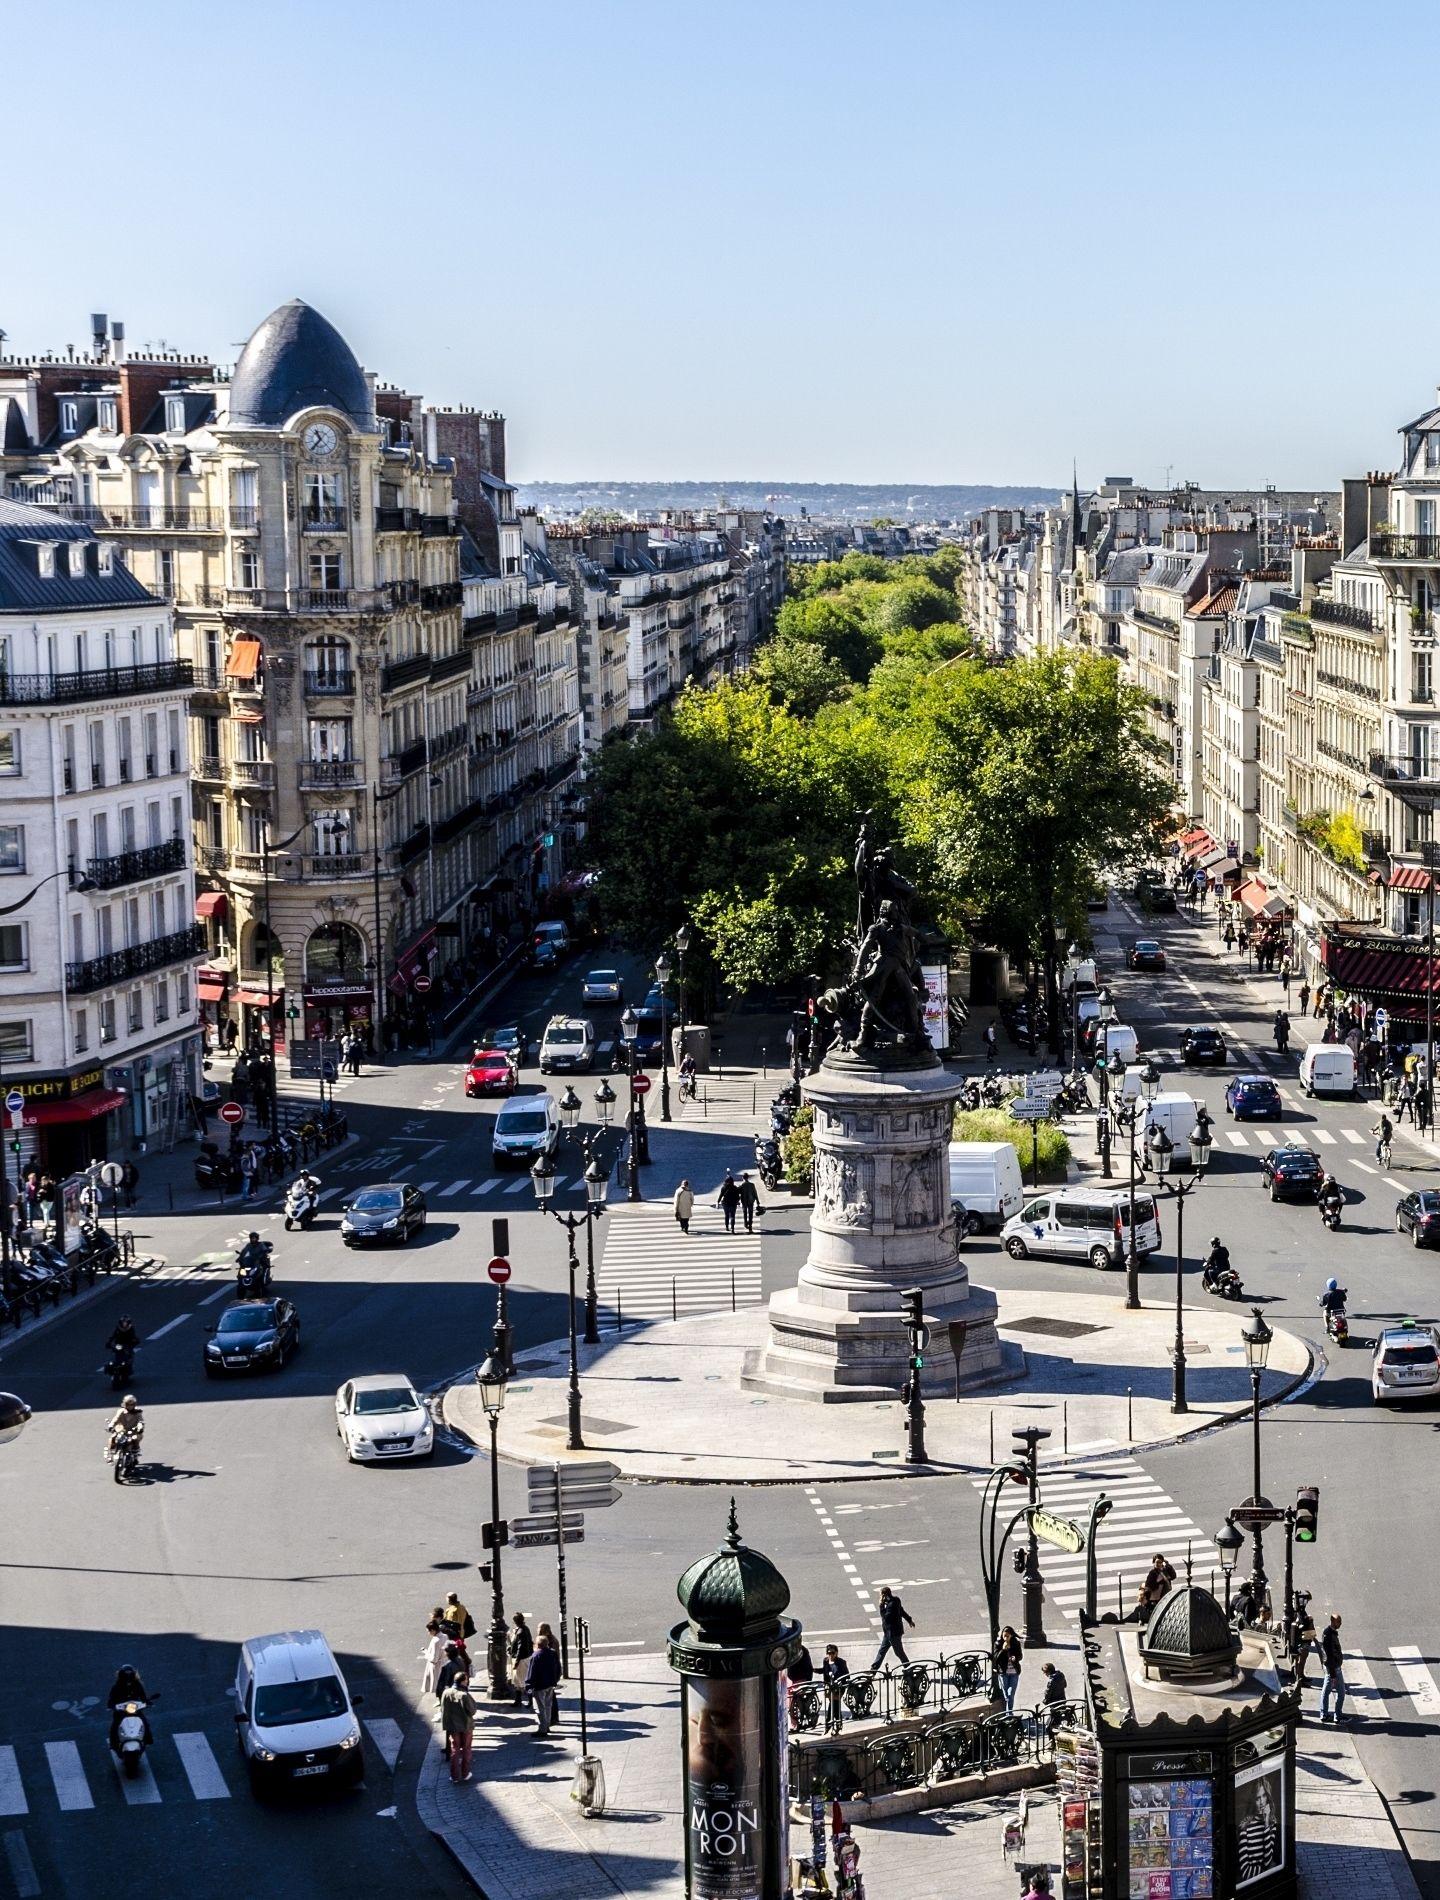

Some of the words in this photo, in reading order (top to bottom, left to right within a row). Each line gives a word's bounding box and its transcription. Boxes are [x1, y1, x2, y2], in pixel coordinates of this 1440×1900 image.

[1363, 941, 1401, 952] Bistro
[312, 985, 366, 995] hippopotamus
[1152, 1760, 1187, 1771] Presse
[691, 1806, 758, 1832] MON
[700, 1832, 746, 1856] ROI
